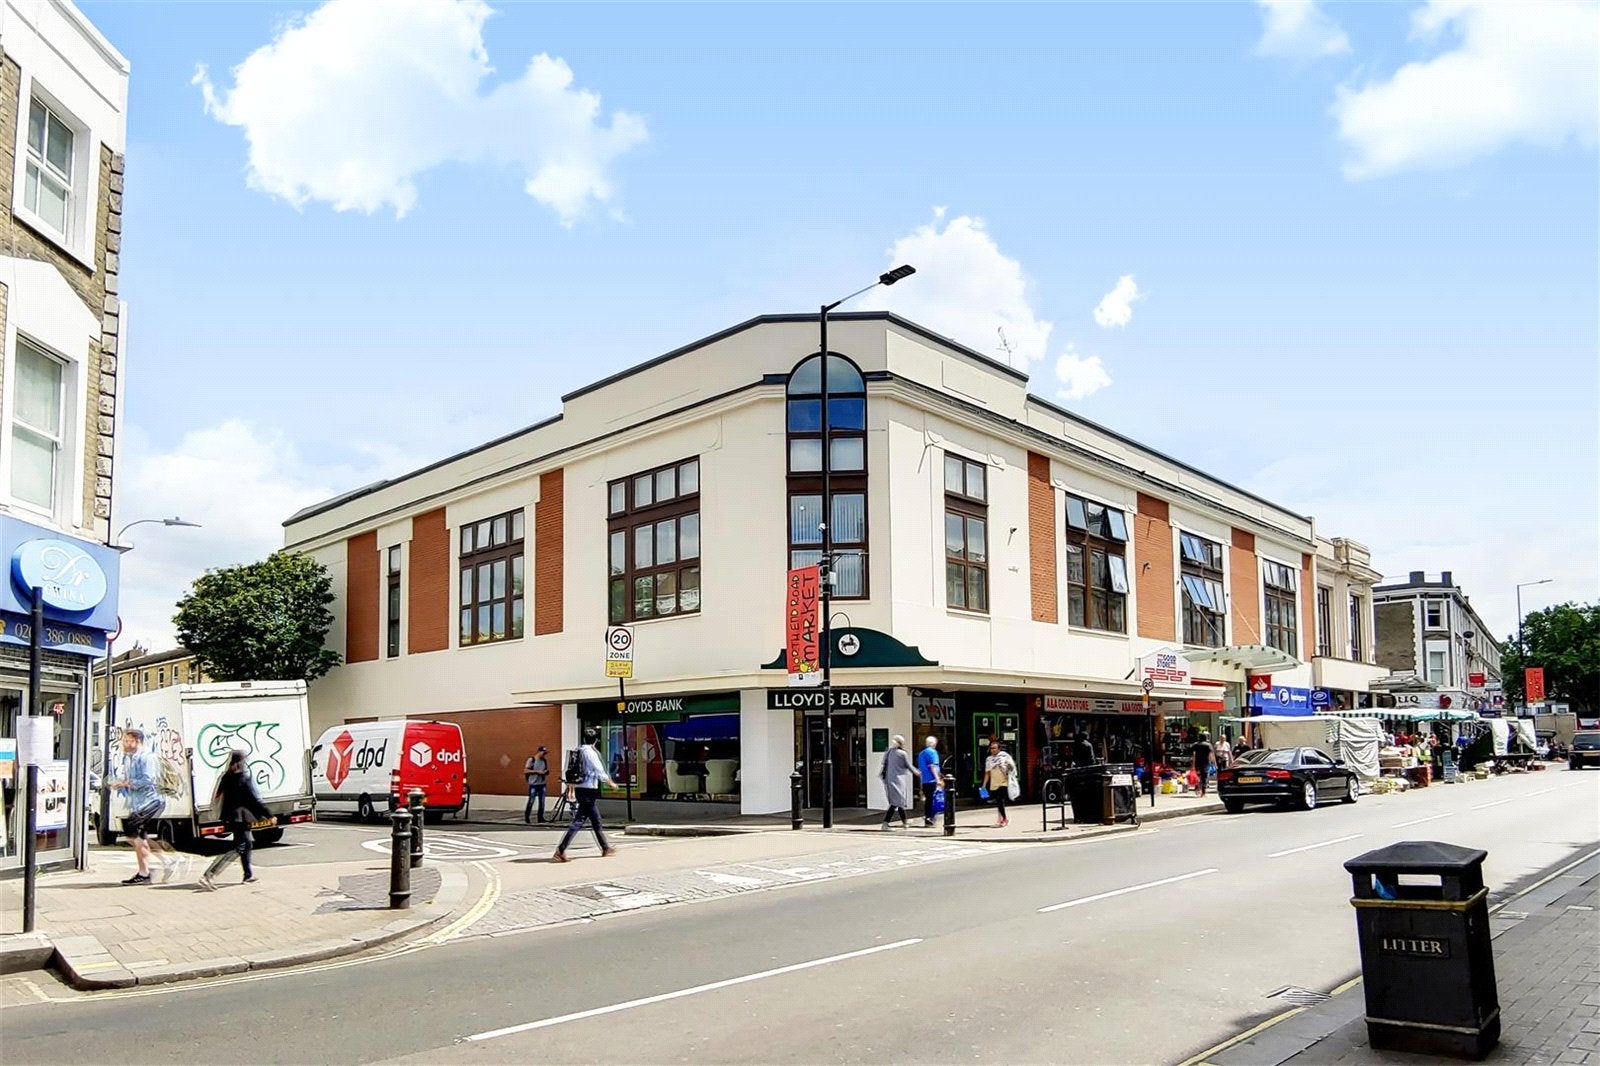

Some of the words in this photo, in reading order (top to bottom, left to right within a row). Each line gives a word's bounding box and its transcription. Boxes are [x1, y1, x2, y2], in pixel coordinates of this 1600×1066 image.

[613, 634, 629, 645] 20
[619, 701, 653, 714] OYDS
[655, 699, 683, 712] BANK
[774, 693, 835, 707] LLOYDS
[840, 692, 885, 706] BANK
[1058, 699, 1072, 710] GOOD
[356, 738, 388, 774] dpd
[436, 748, 461, 764] dpd
[1383, 938, 1443, 954] LITTER
